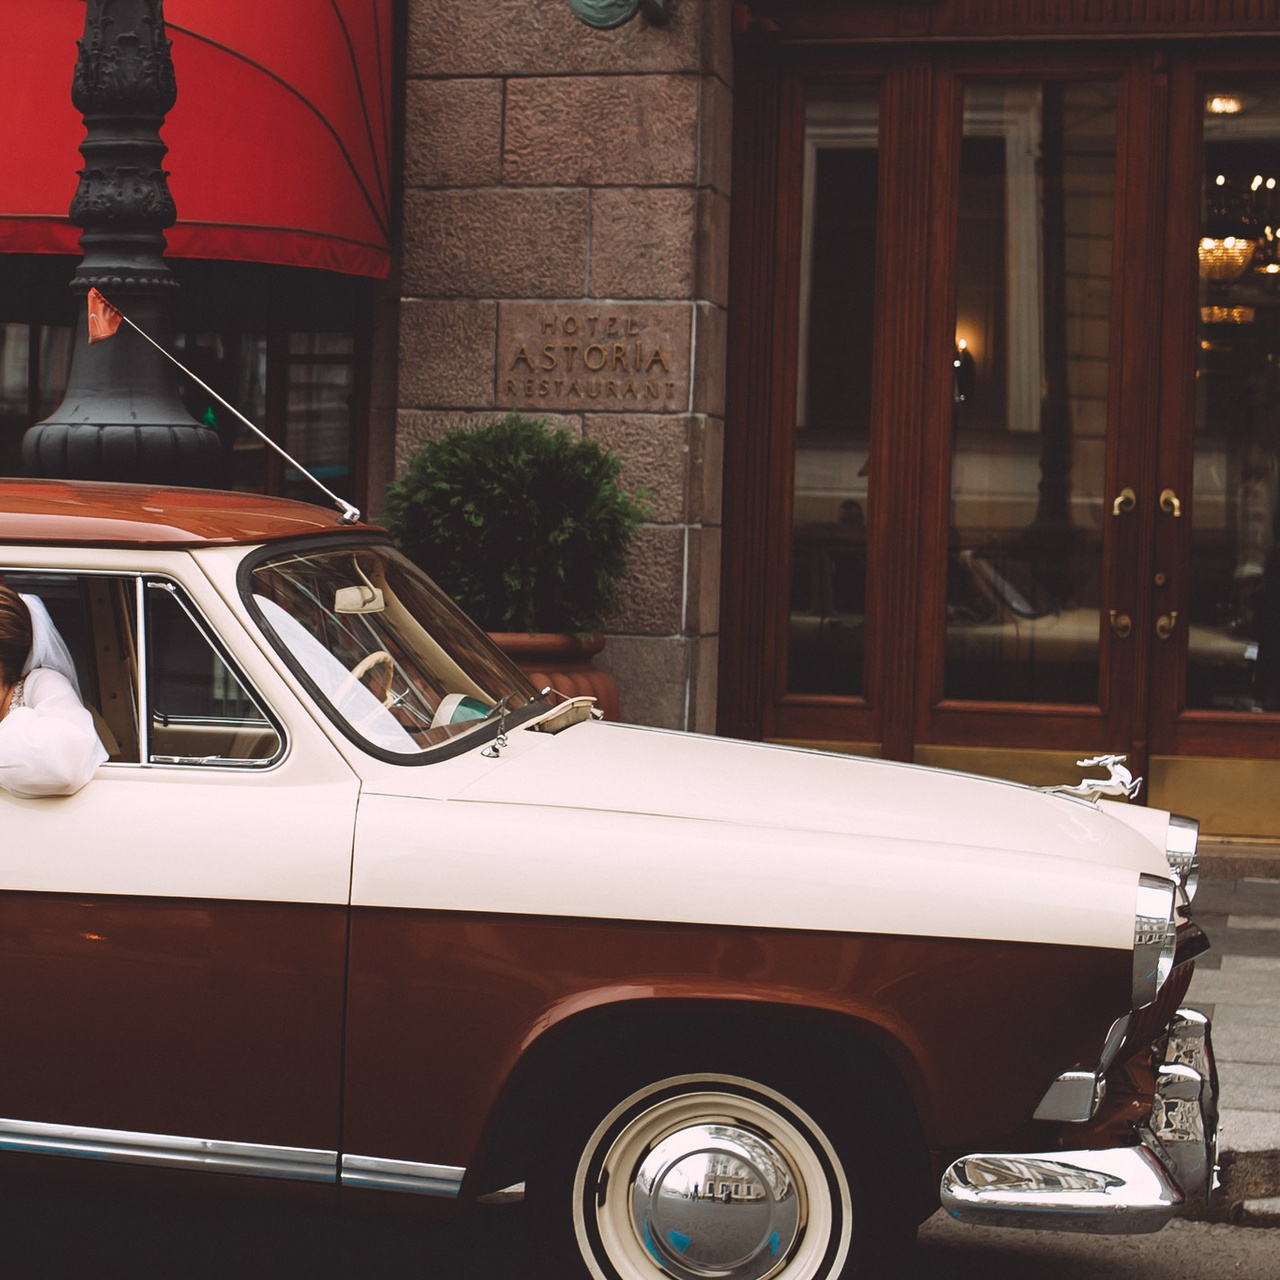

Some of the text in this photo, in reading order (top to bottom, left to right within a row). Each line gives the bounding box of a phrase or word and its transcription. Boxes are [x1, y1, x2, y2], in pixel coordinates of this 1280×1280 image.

[541, 315, 641, 336] HOTEL
[510, 340, 670, 373] ASTORIA
[506, 379, 675, 399] RESTAURANT
